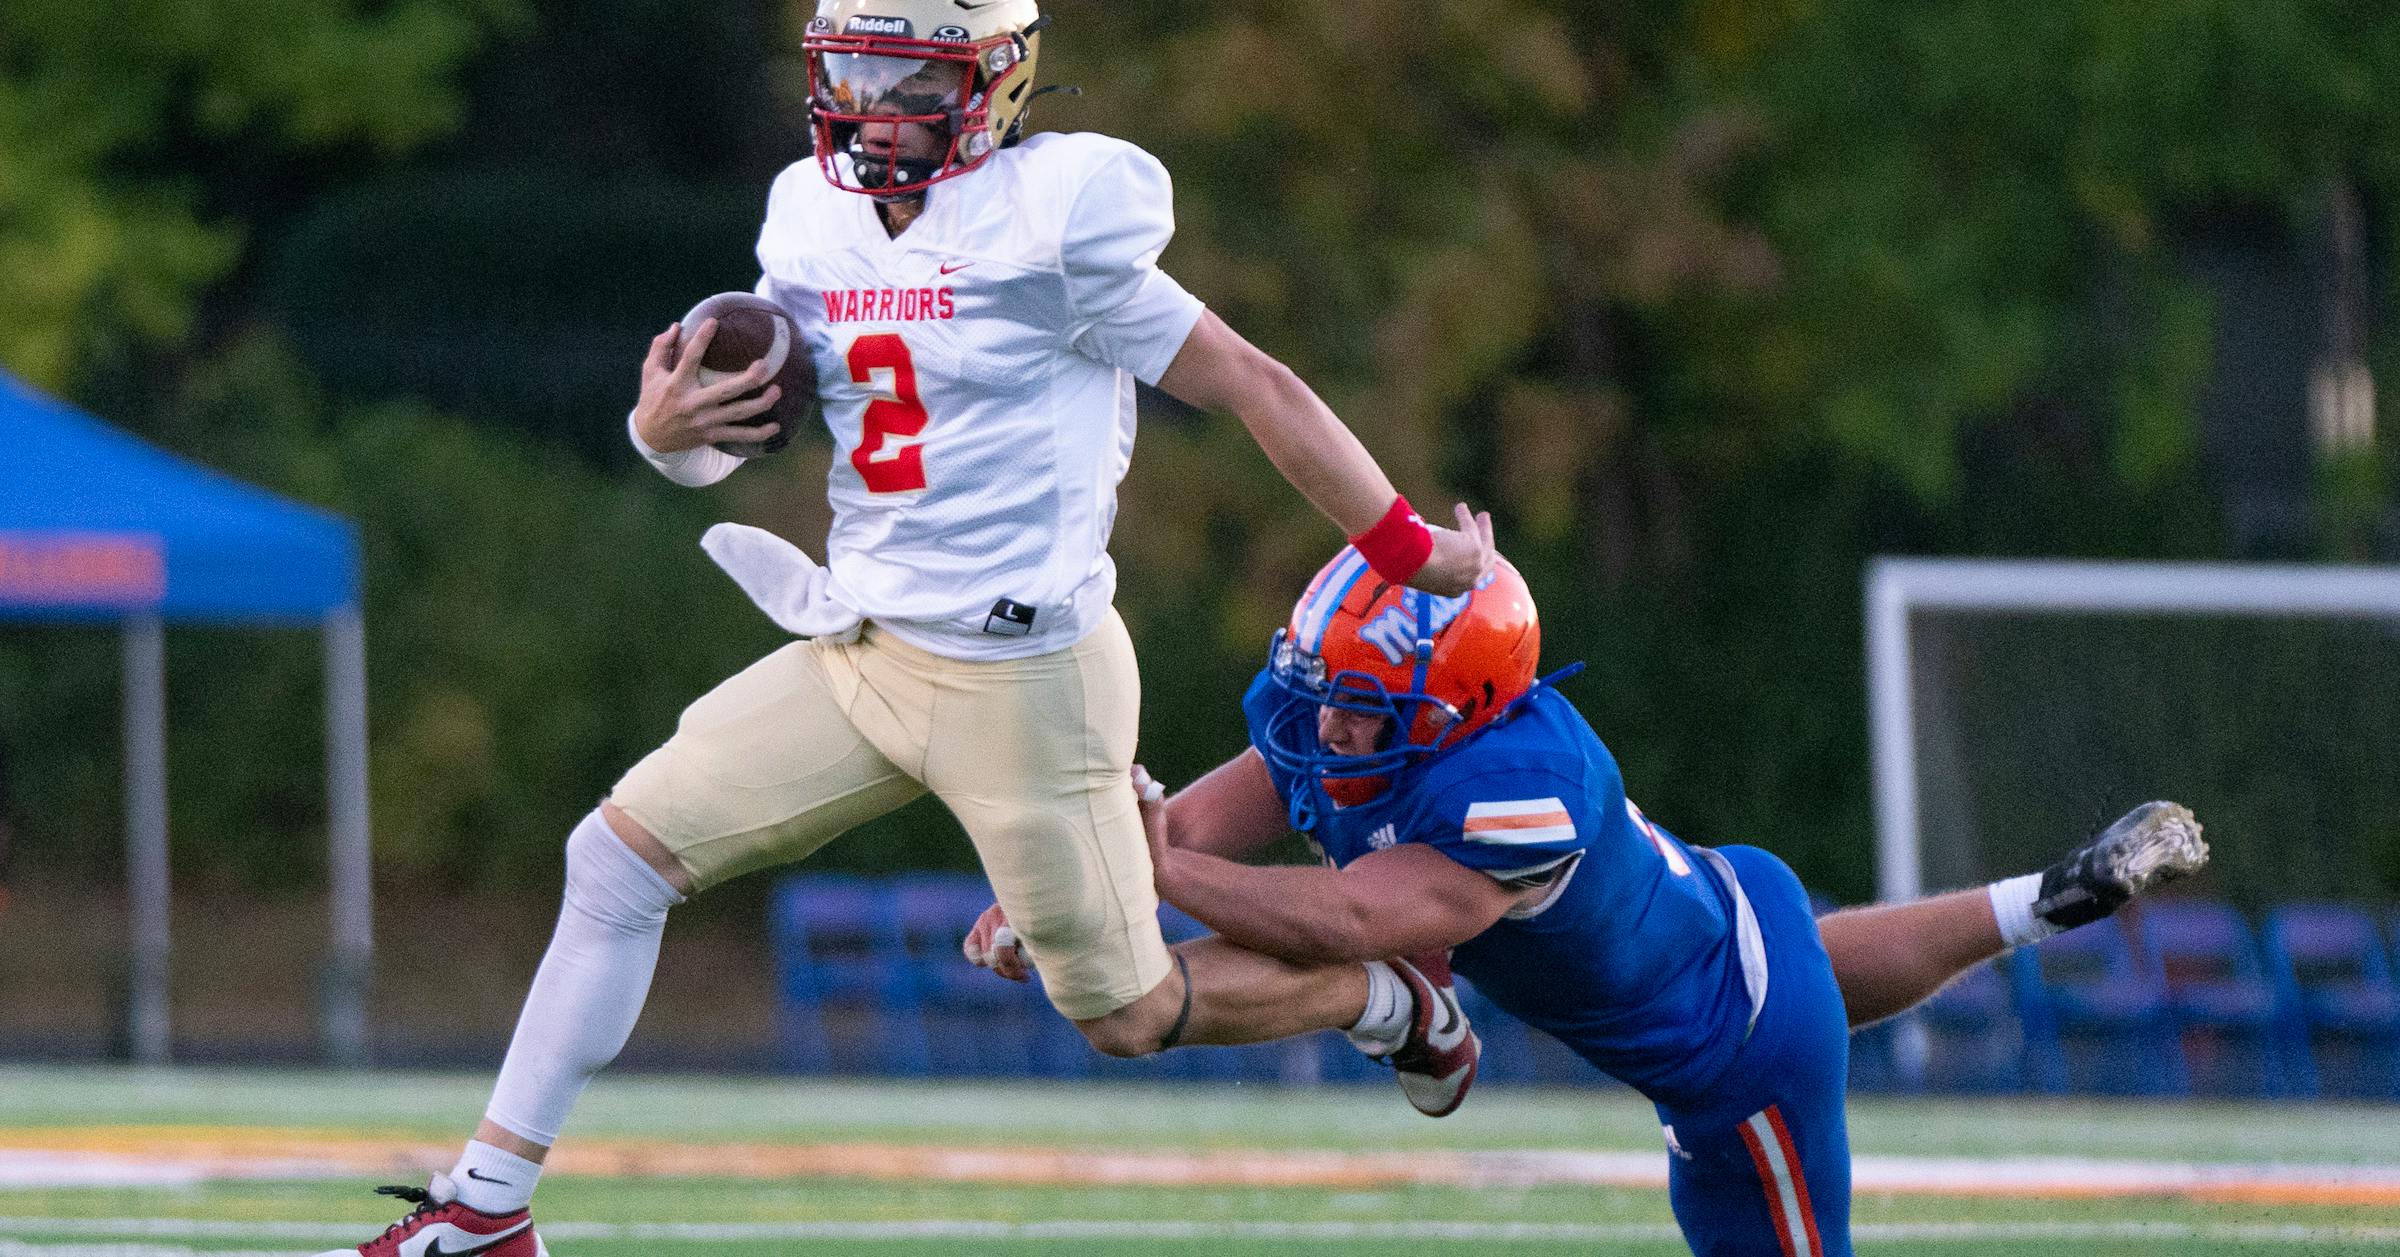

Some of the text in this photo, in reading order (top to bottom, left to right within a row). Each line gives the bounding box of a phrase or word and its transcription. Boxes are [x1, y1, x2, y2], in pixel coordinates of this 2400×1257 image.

[848, 16, 905, 33] Riddell
[822, 287, 955, 323] WARRIORS
[845, 332, 929, 494] 2
[1006, 603, 1018, 619] L
